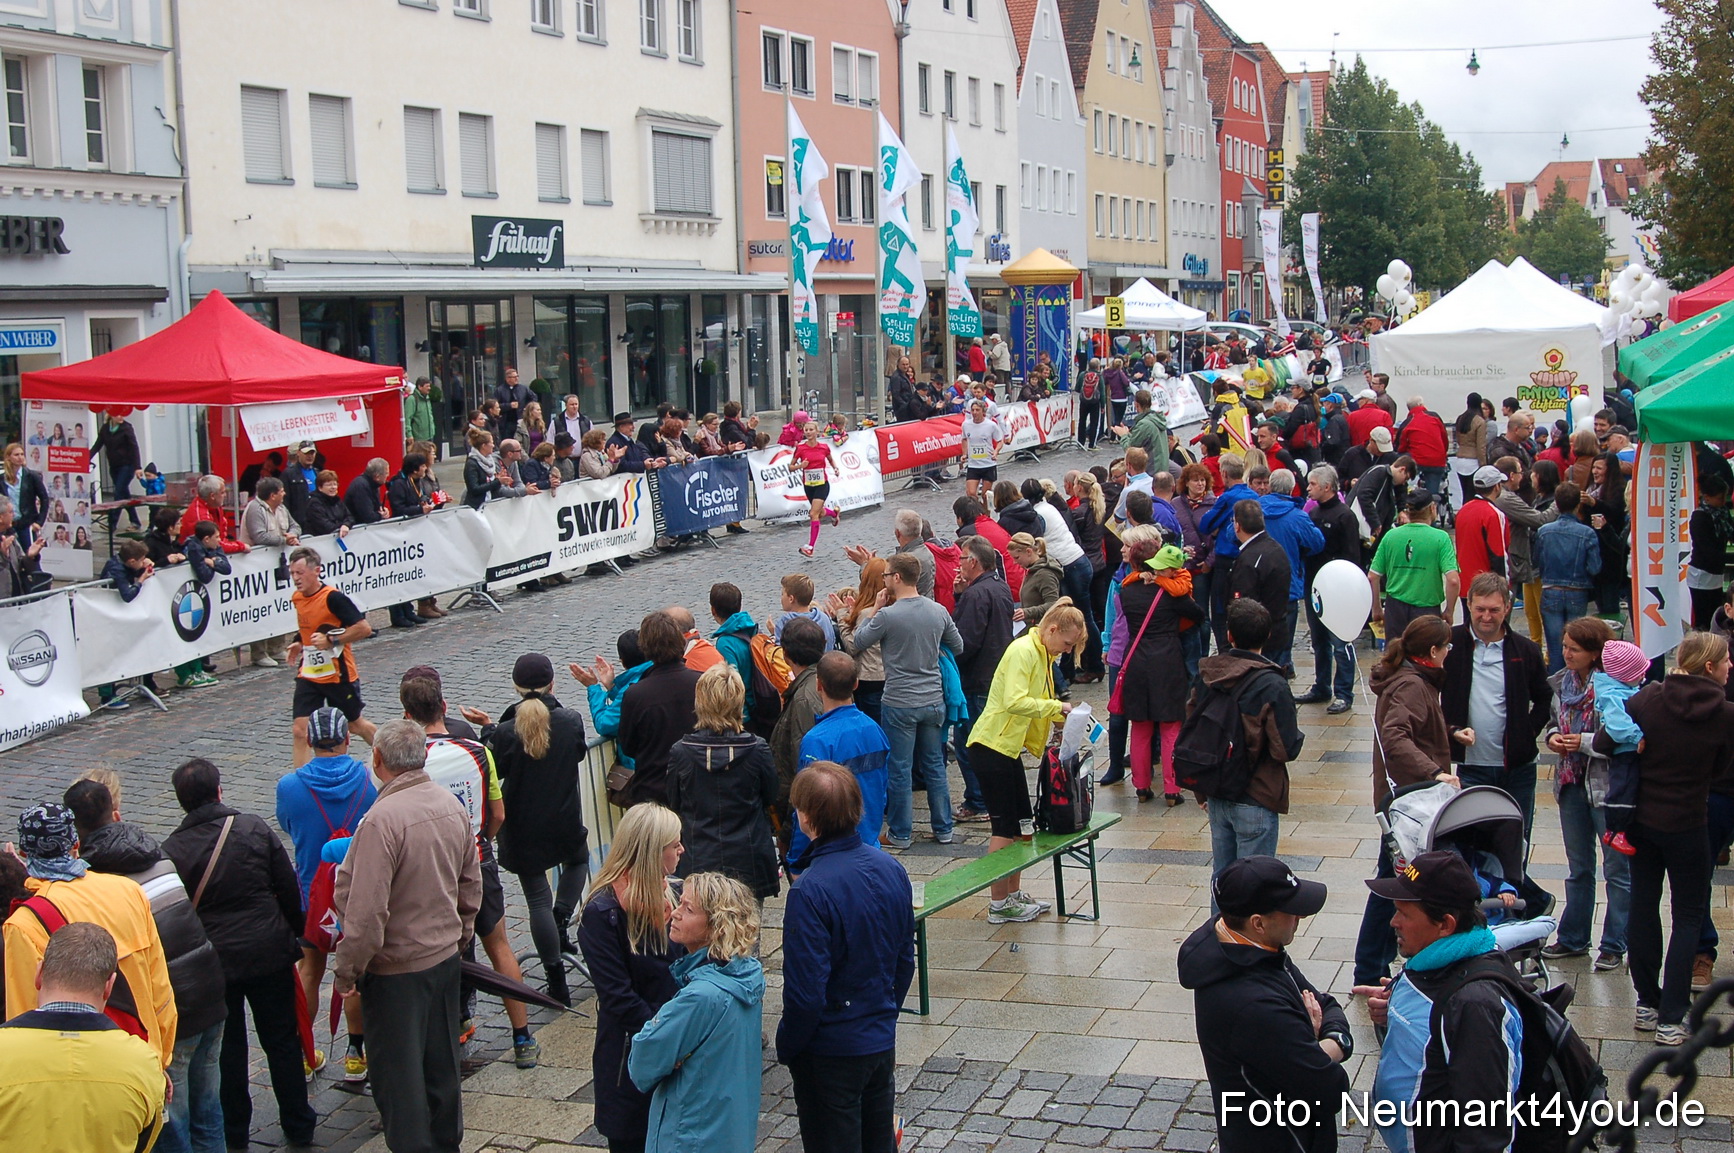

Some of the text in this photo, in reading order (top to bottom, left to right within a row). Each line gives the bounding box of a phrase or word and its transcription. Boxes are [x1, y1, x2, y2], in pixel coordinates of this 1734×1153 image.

[480, 221, 562, 264] frühauf
[749, 243, 784, 255] sutor.
[1110, 307, 1120, 321] B
[13, 331, 53, 346] WEBER
[1394, 364, 1506, 377] Kinder brauchen Sie.
[280, 411, 338, 430] LEBENSRETTER!
[912, 435, 941, 454] Herzlich
[972, 447, 985, 455] 573
[845, 454, 858, 466] KIA
[808, 473, 820, 481] 396
[695, 484, 739, 509] Fischer
[557, 498, 619, 542] swn
[220, 570, 269, 604] BMW
[221, 605, 273, 627] Weniger
[274, 598, 292, 614] Ver
[365, 566, 426, 591] Fahrfreude.
[11, 650, 52, 666] NISSAN
[449, 781, 465, 789] Welt
